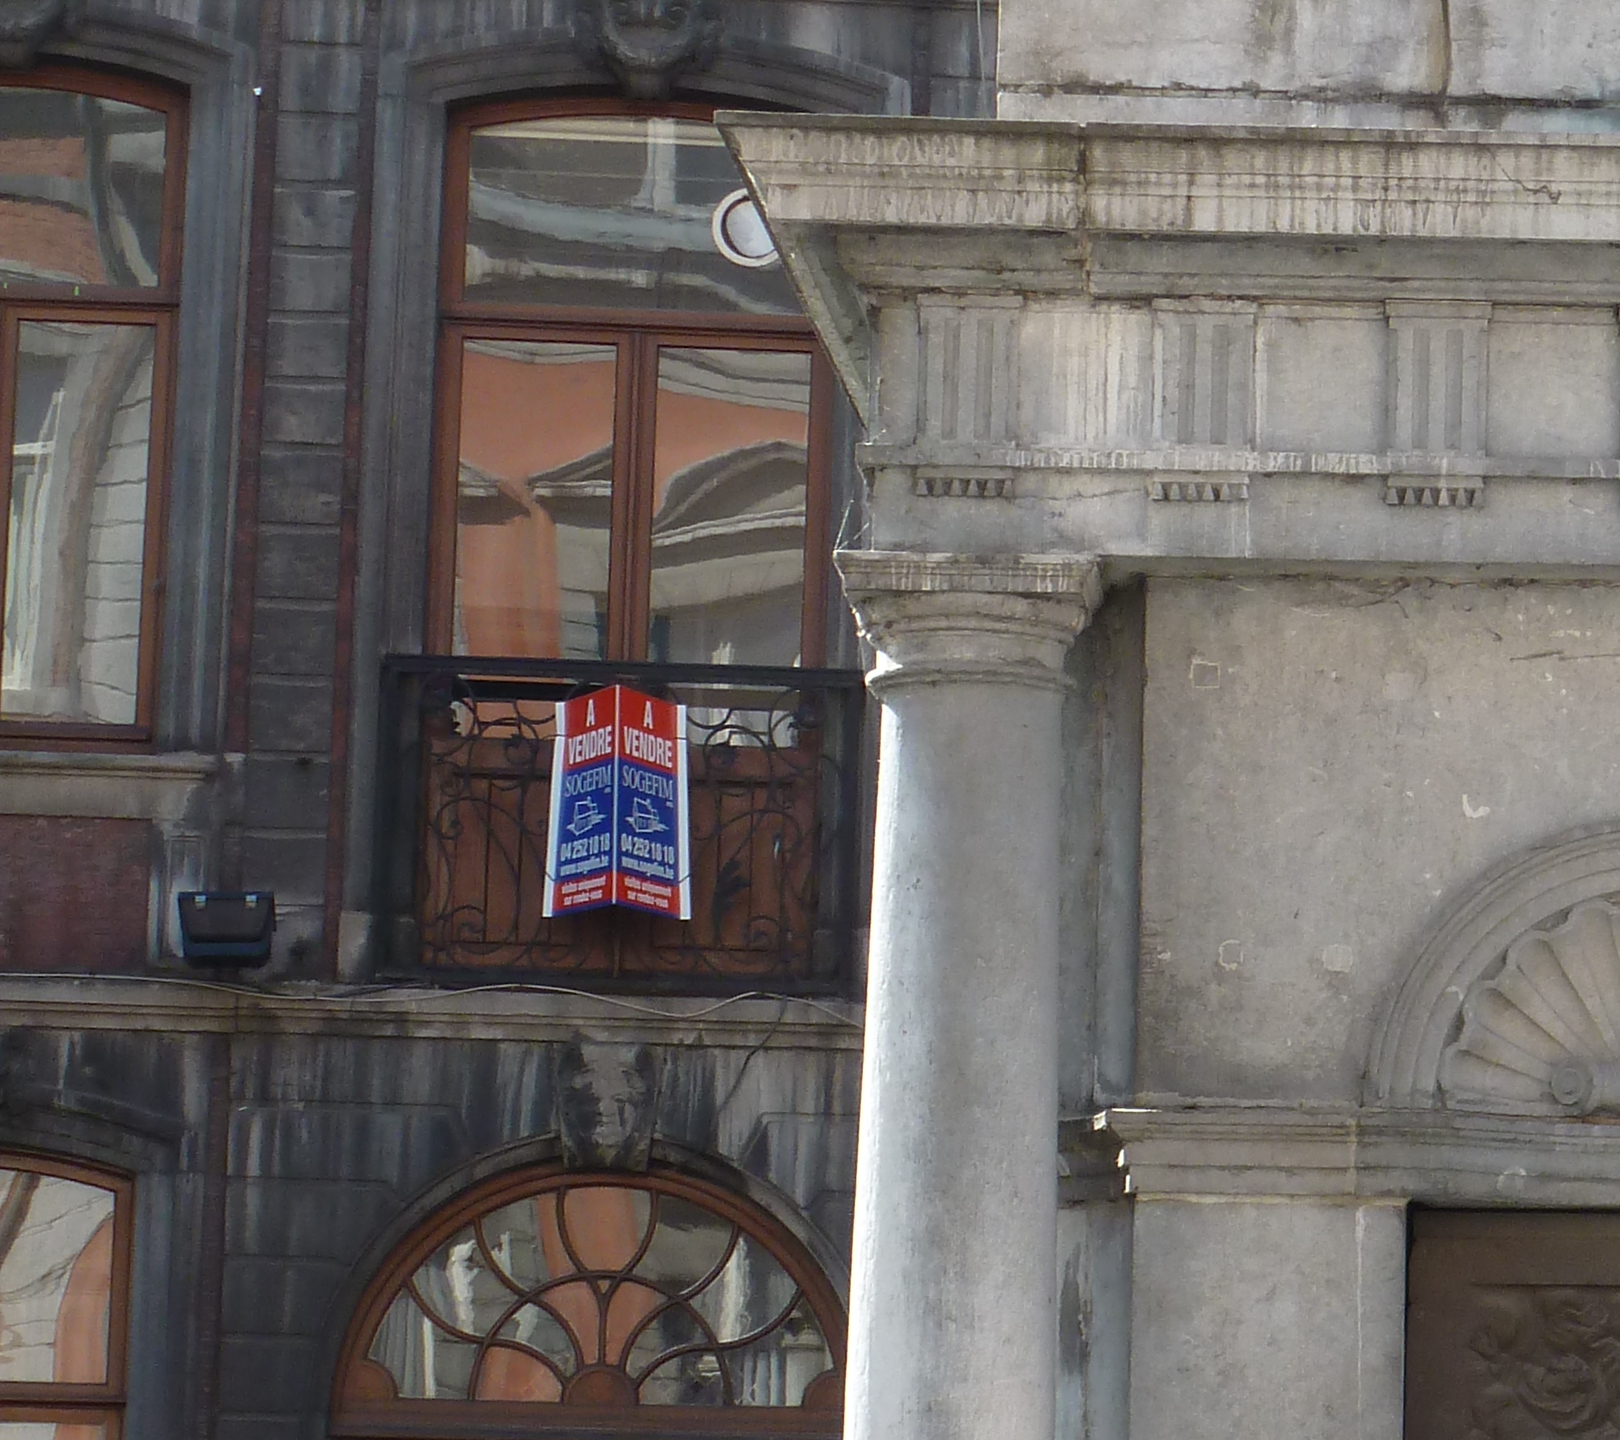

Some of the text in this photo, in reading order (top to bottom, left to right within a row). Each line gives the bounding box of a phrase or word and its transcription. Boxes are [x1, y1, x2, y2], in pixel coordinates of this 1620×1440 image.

[586, 699, 595, 727] A
[643, 700, 653, 729] A
[568, 725, 612, 765] VENDRE
[623, 725, 673, 768] VENDRE
[564, 764, 612, 798] SOGEFIM
[622, 765, 673, 800] SOGEFIM
[621, 833, 632, 853] 04
